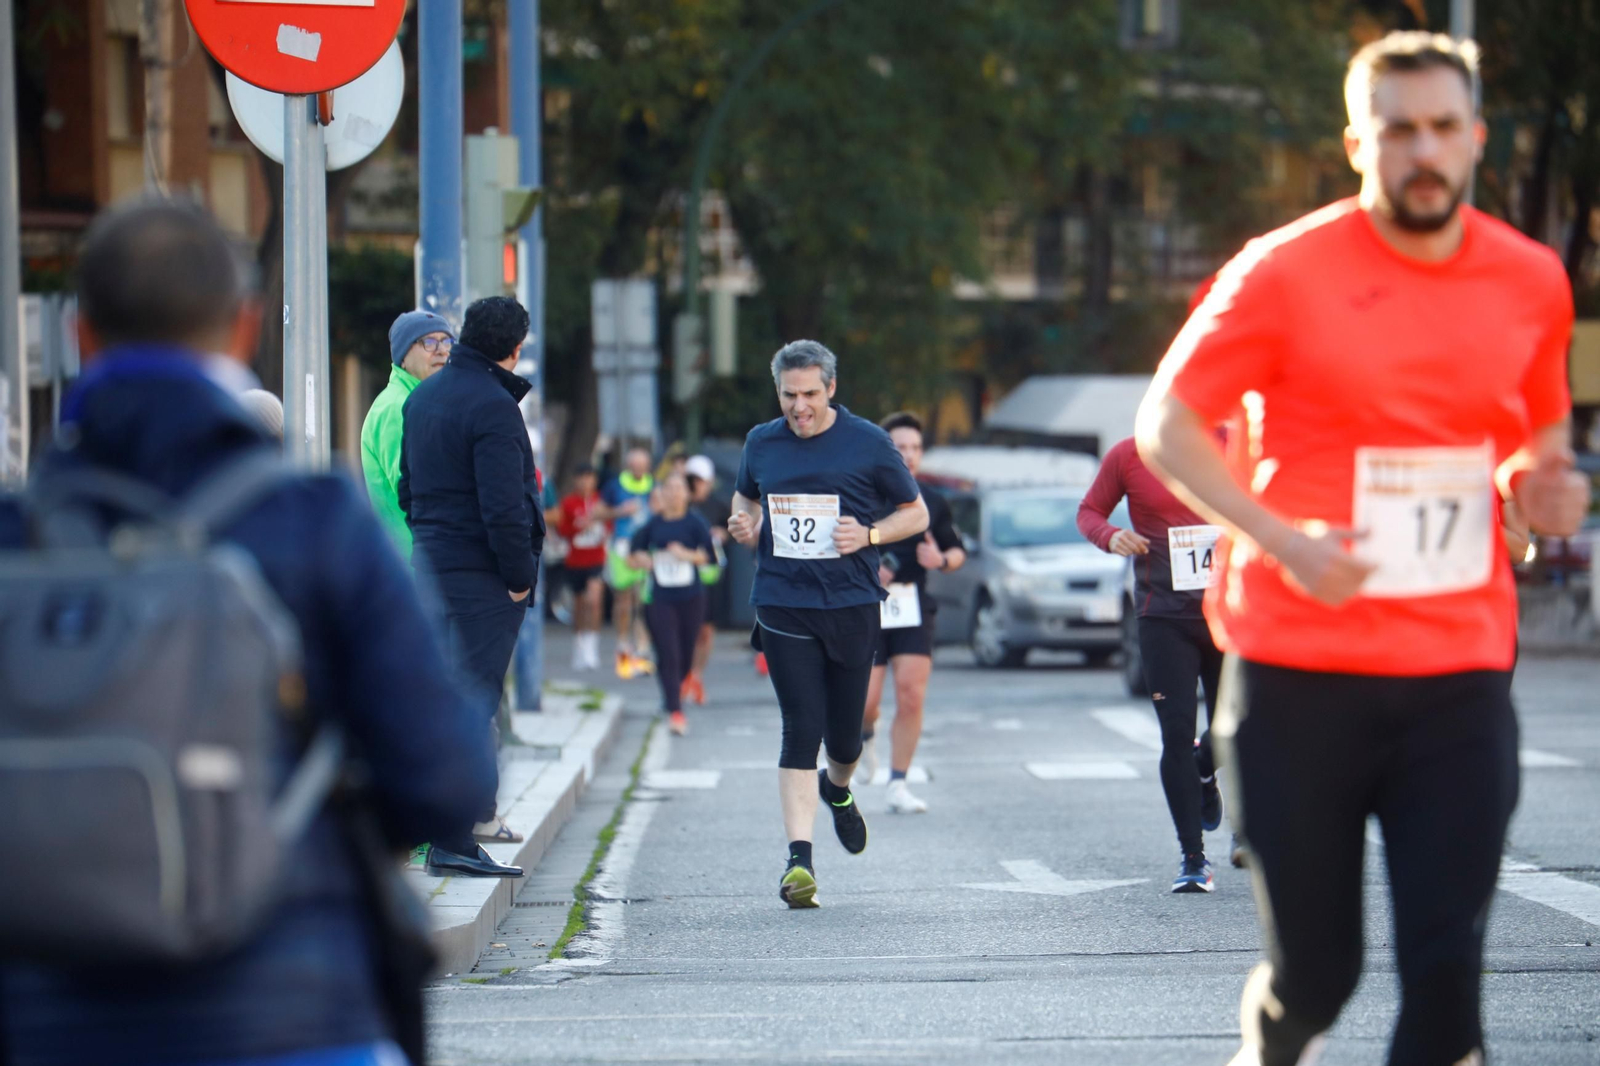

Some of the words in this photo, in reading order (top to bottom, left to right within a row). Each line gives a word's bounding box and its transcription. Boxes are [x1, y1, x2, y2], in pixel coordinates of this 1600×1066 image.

[789, 517, 816, 543] 32
[1415, 498, 1461, 556] 17
[1187, 548, 1213, 574] 14
